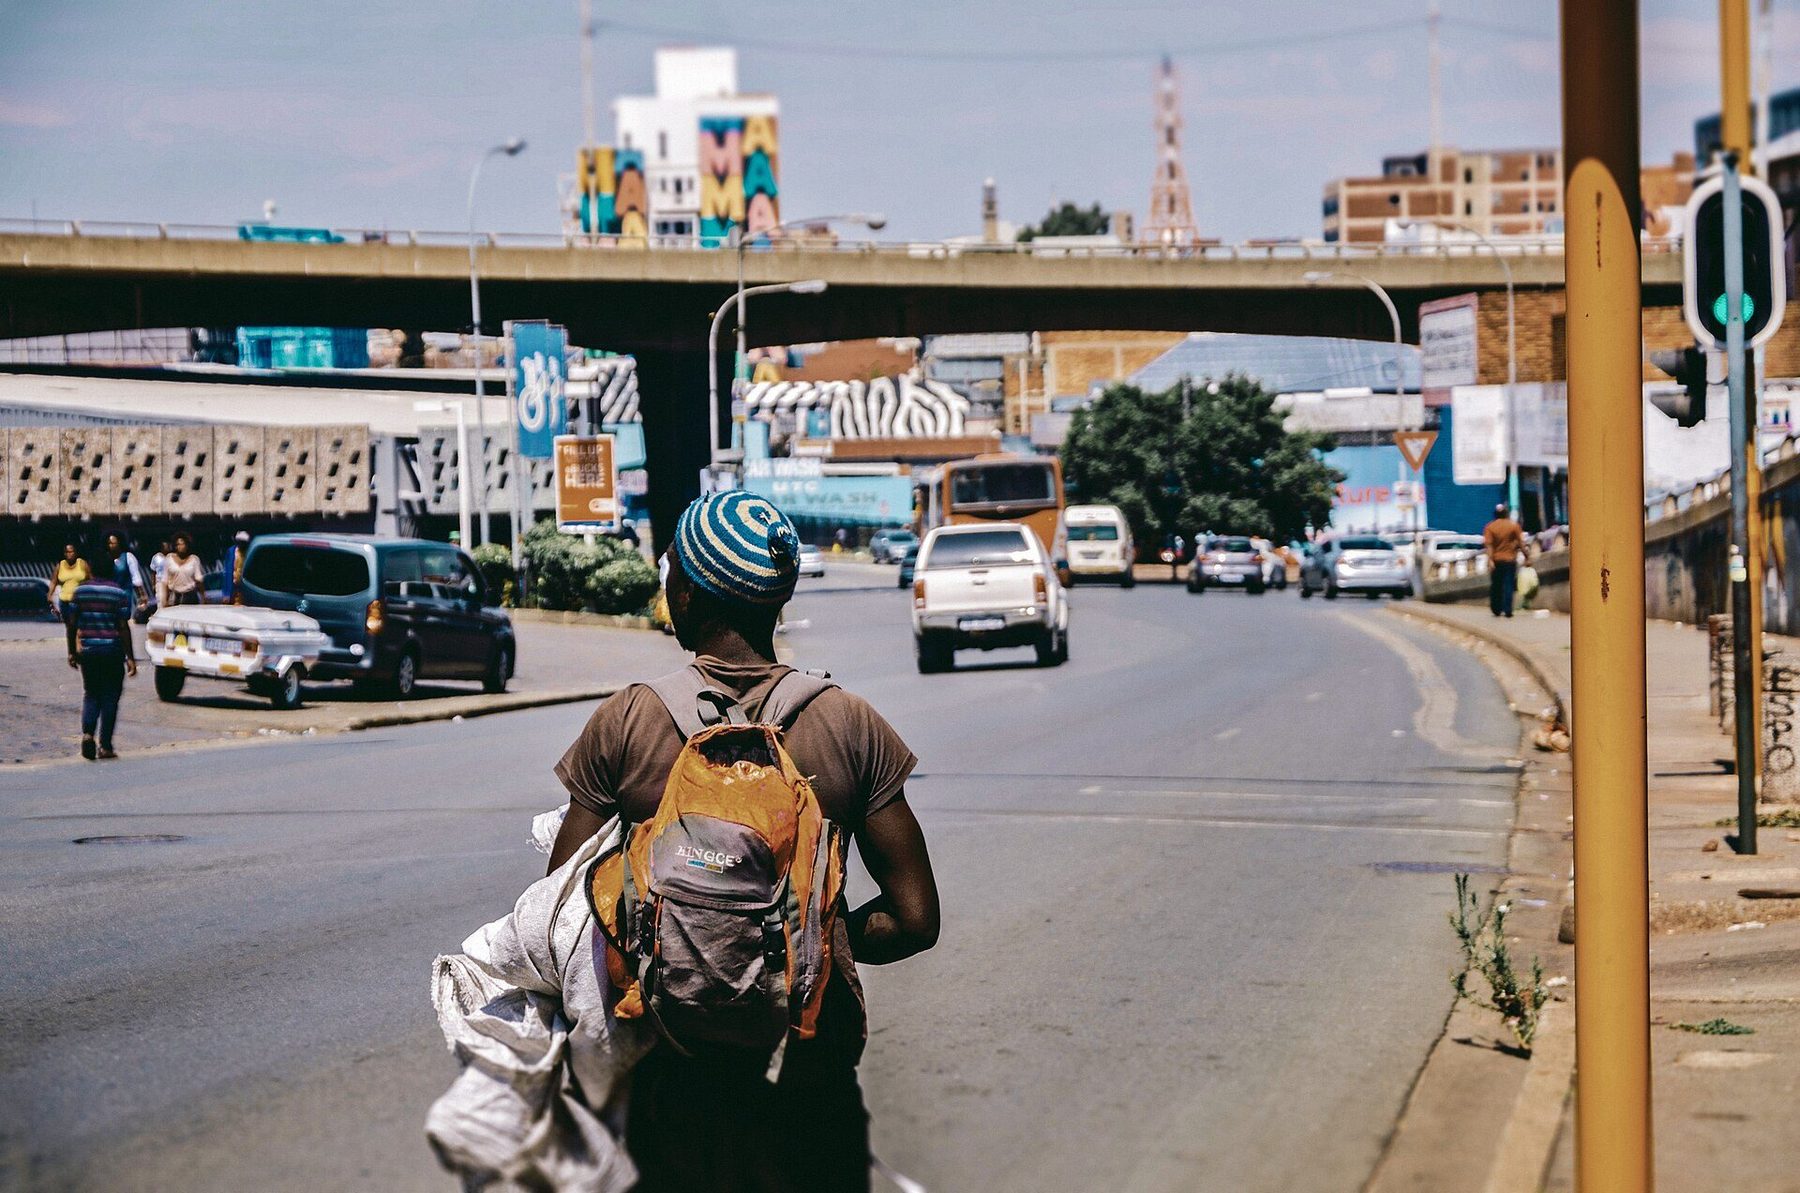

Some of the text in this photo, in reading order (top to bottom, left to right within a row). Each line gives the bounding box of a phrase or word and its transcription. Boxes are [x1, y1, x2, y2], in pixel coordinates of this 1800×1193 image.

[588, 444, 604, 455] UP
[564, 472, 606, 488] HERE
[805, 491, 878, 504] WASH
